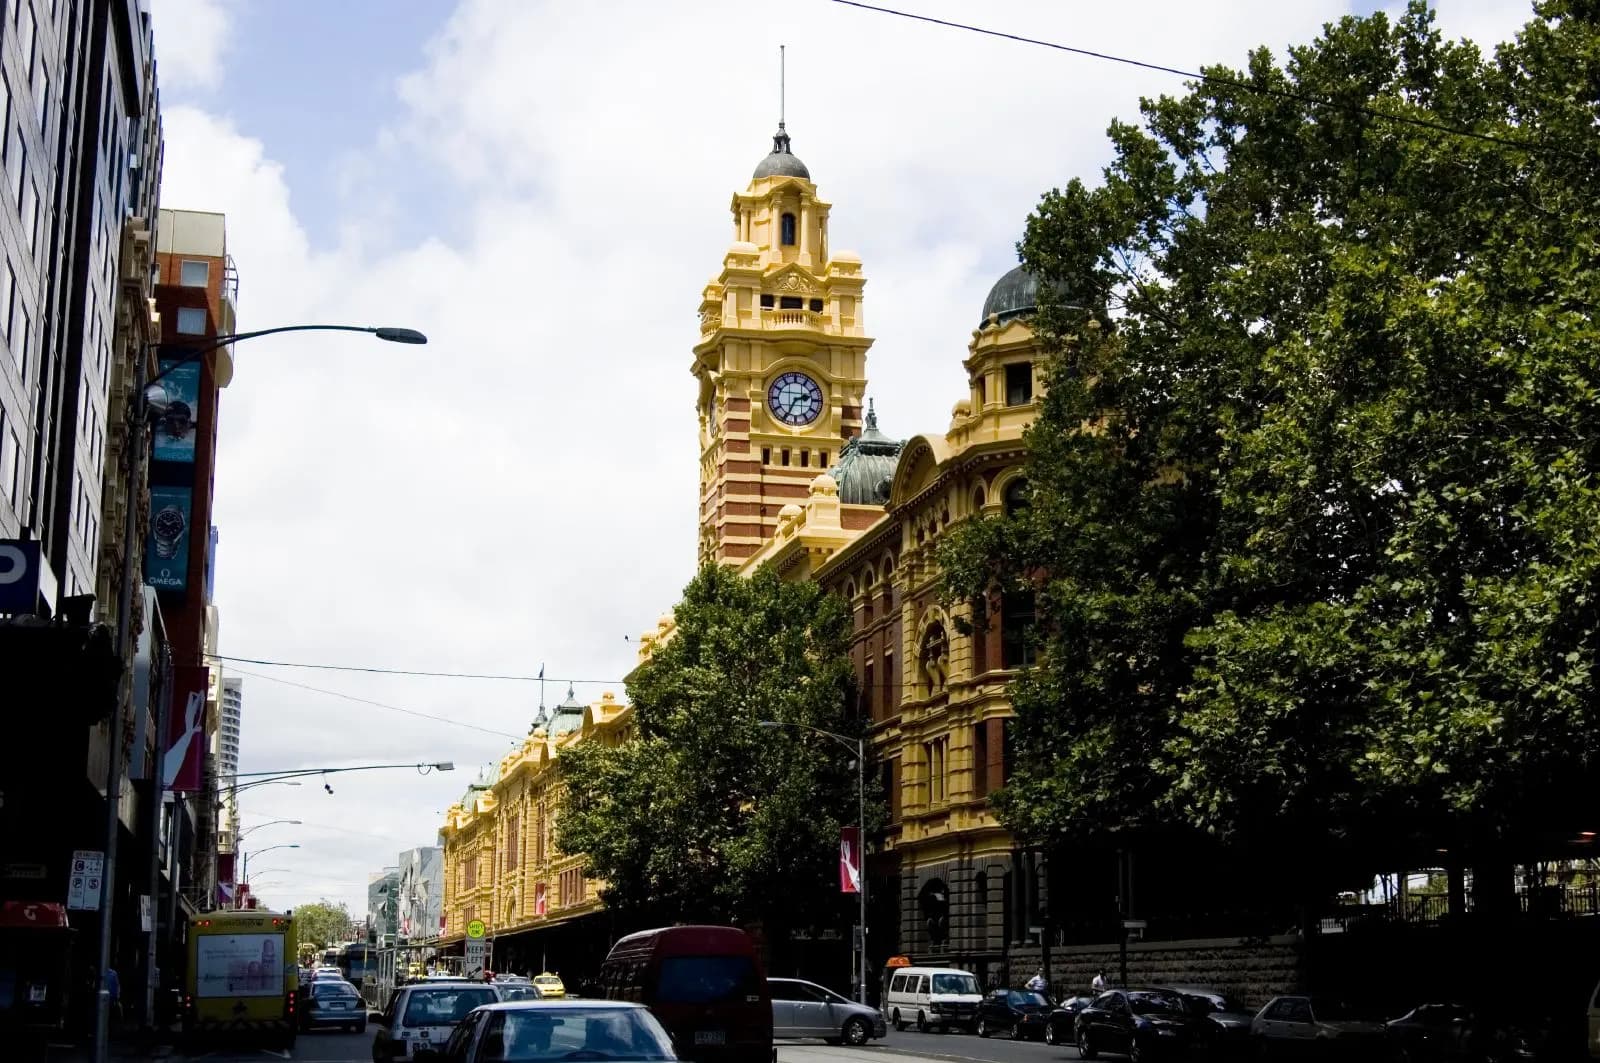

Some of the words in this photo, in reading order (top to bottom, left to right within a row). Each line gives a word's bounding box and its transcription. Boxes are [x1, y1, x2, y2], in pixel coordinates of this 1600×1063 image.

[148, 576, 183, 586] OMEGA
[466, 945, 484, 954] KEEP
[466, 956, 483, 964] LEFT
